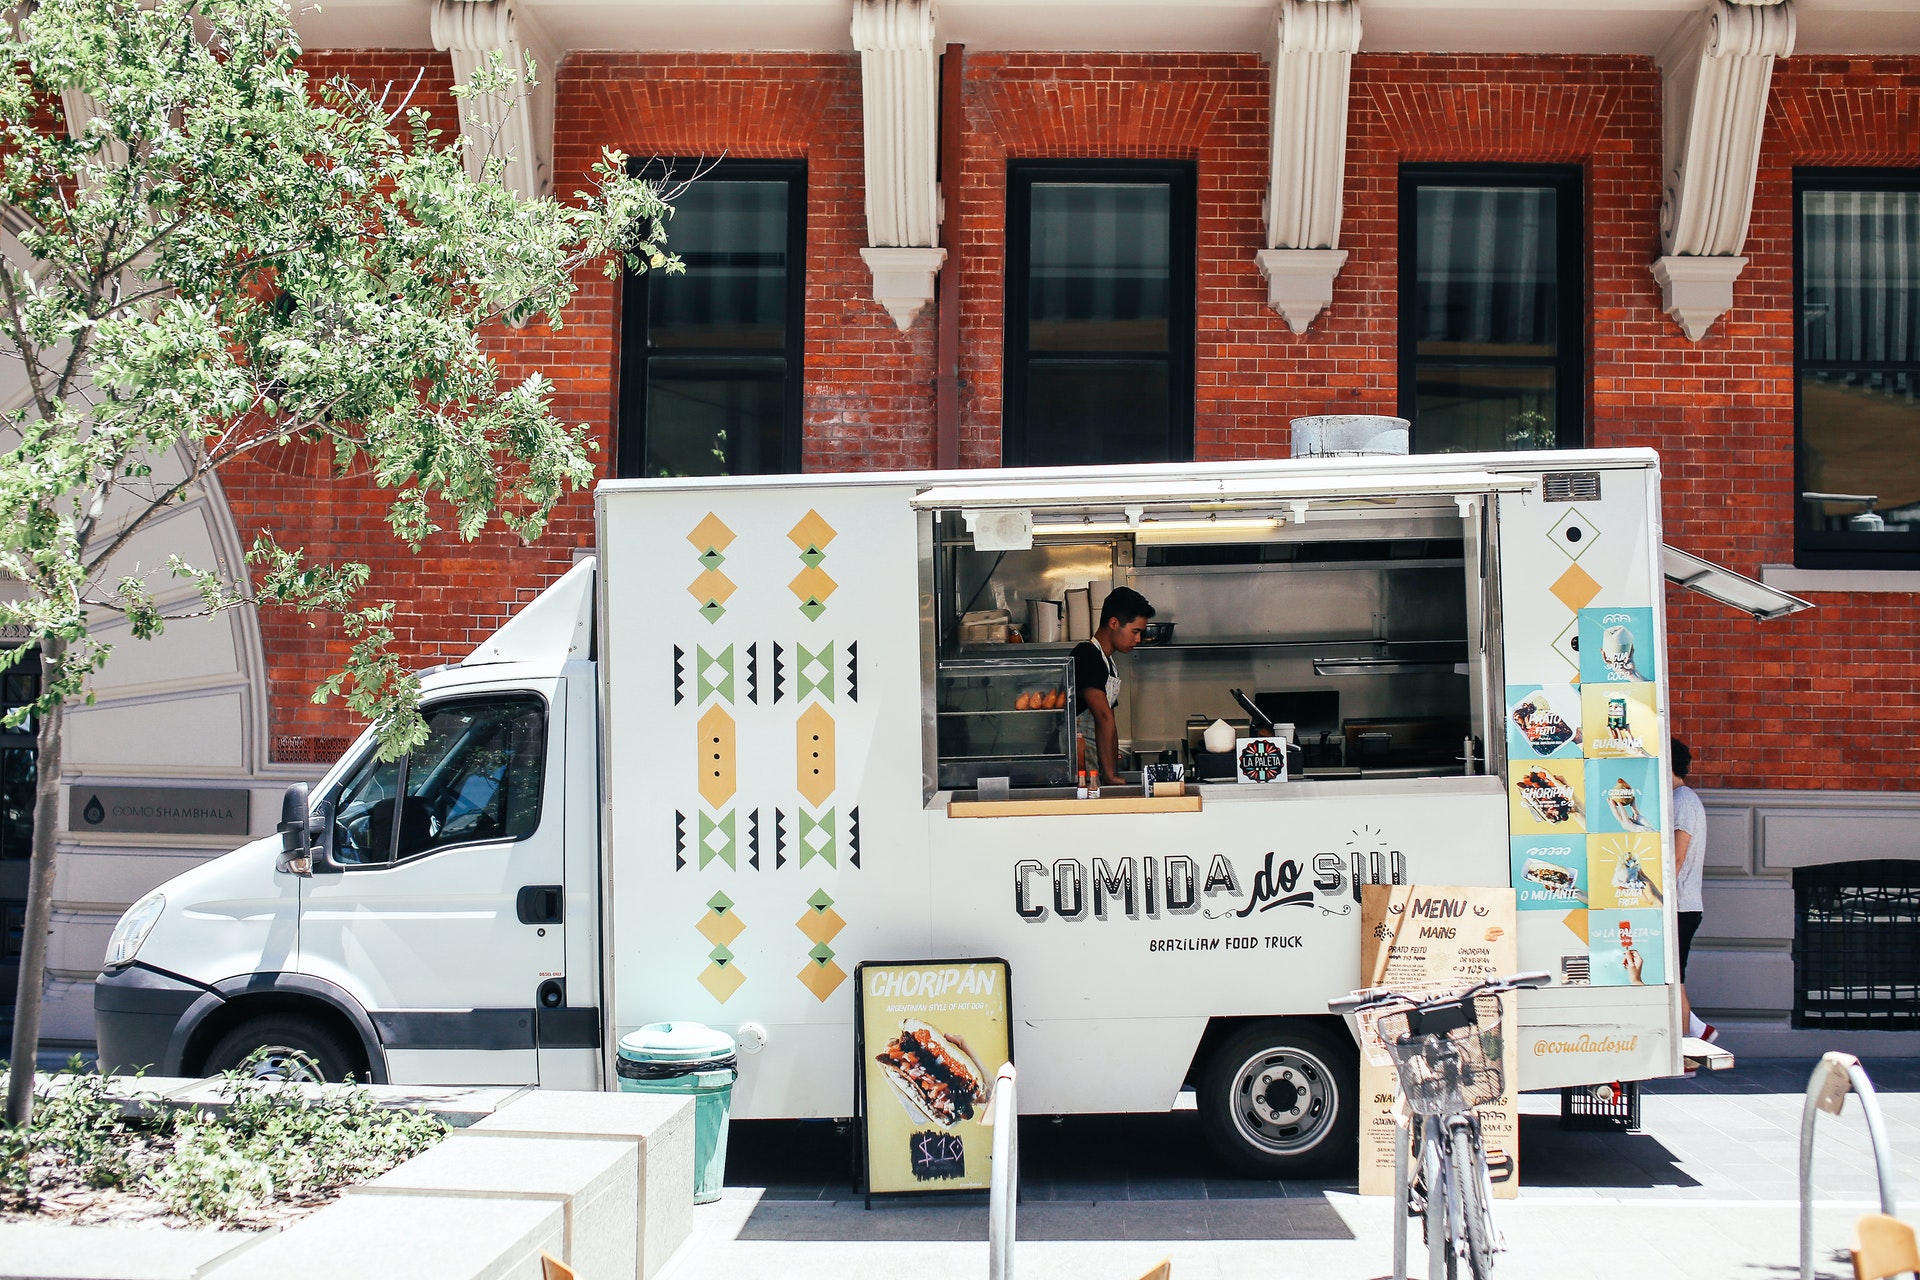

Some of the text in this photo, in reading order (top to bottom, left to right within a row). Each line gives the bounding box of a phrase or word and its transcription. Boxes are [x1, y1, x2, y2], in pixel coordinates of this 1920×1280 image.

[1607, 671, 1630, 681] COCO
[1243, 756, 1281, 768] LA PALETA
[112, 806, 233, 819] COMO SHAMBHALA
[1015, 852, 1244, 923] COMIDA
[1236, 851, 1304, 918] do
[1520, 888, 1579, 901] O MUTANTE
[1411, 898, 1467, 919] MENU
[1603, 927, 1649, 938] LA PALETA
[1225, 937, 1258, 950] FOOD
[1264, 935, 1303, 949] TRUCK
[1388, 945, 1409, 954] PRATO
[885, 1002, 985, 1013] ARGENTINIAN STYLE OF HOT DOG
[1533, 1033, 1639, 1057] @comidadosul
[917, 1135, 965, 1168] $10
